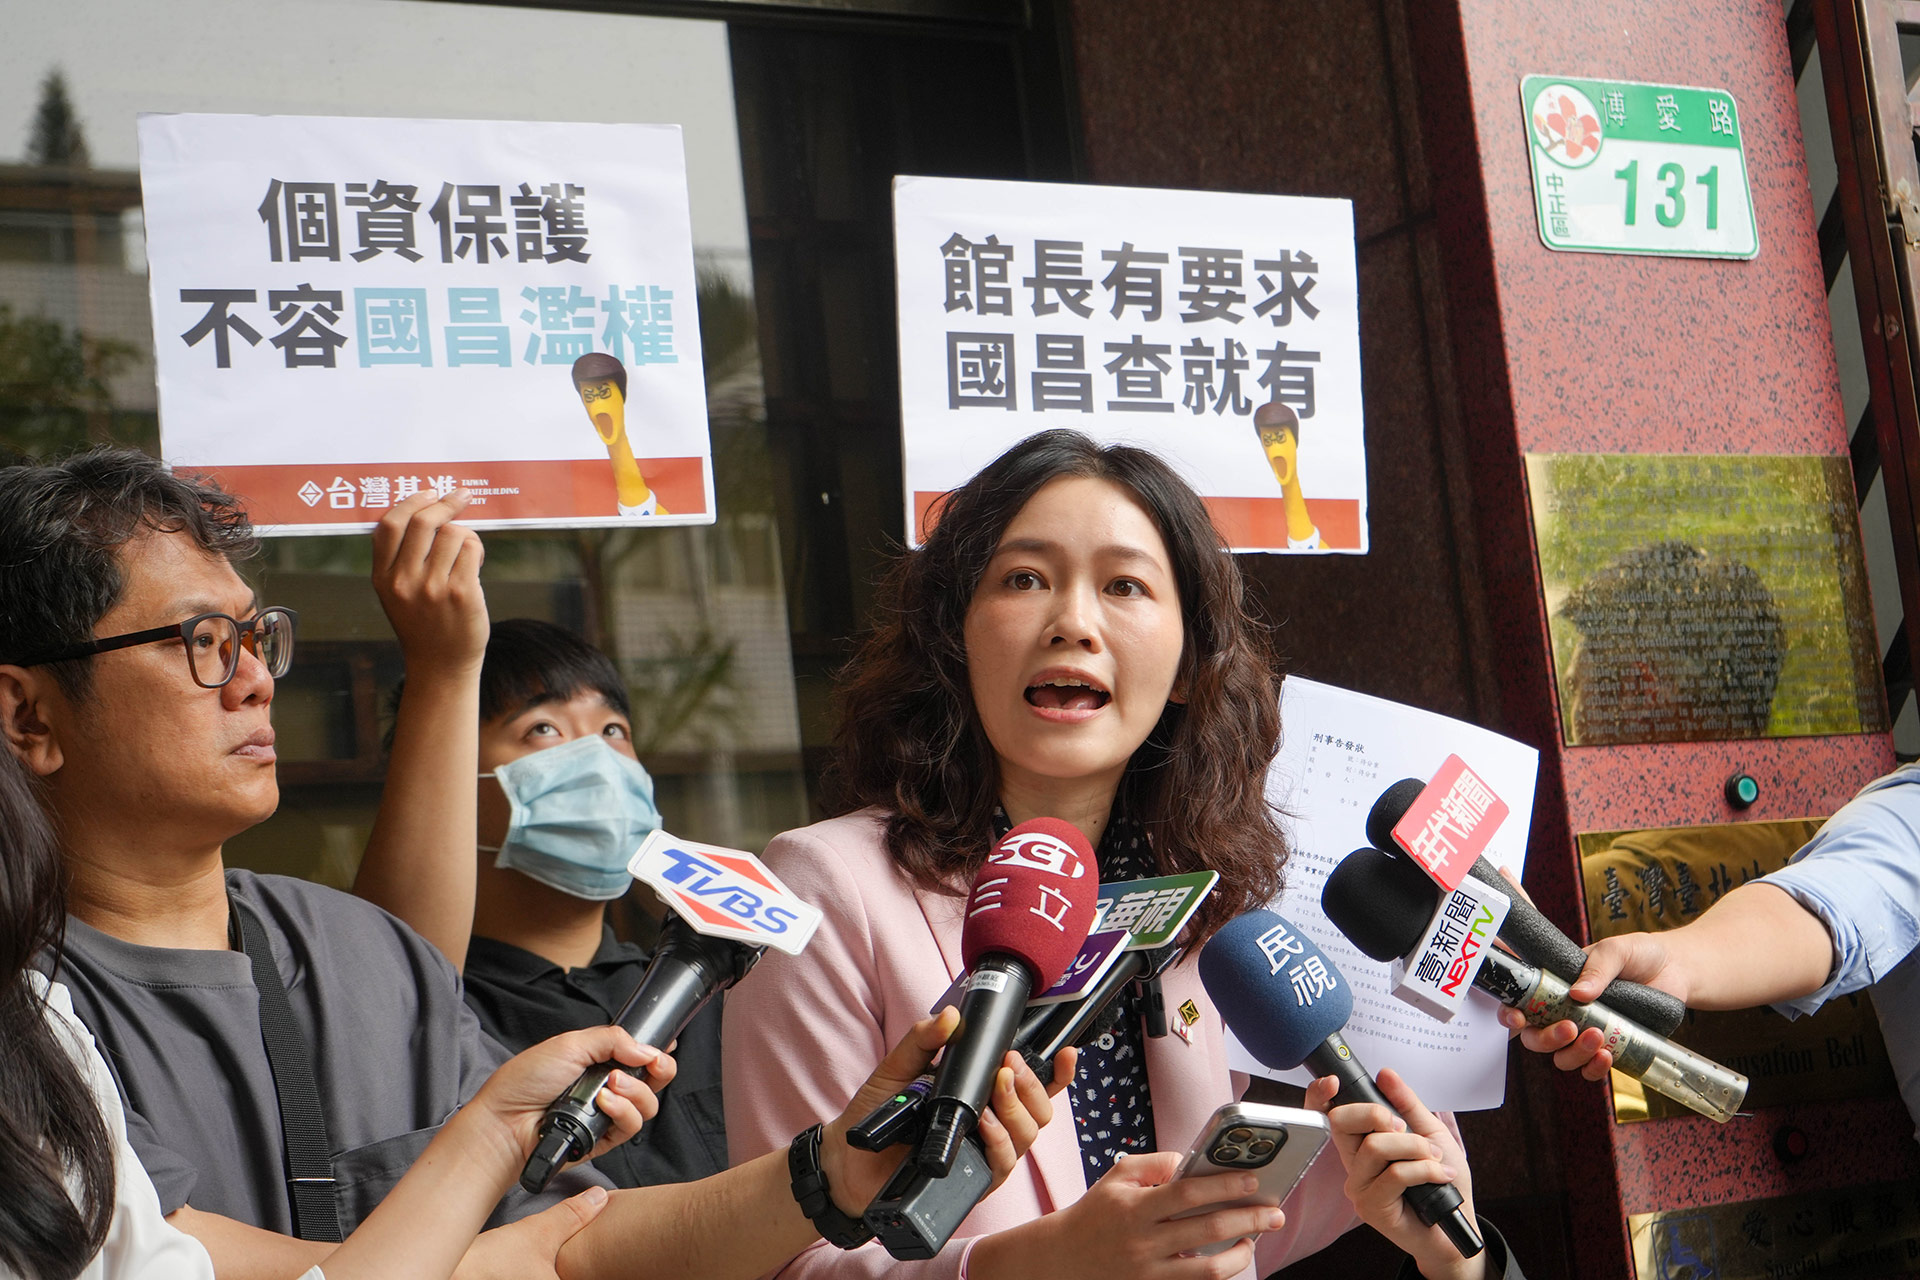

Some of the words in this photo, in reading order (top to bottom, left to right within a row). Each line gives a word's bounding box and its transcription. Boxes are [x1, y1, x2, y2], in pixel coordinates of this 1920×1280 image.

[1600, 89, 1735, 136] 博愛路
[257, 177, 593, 265] 個資保護
[1546, 172, 1571, 238] 中正區
[1614, 159, 1719, 230] 131
[939, 231, 1321, 328] 館長有要求
[178, 282, 680, 369] 不容國昌濫權
[945, 331, 1322, 420] 國昌查就有
[1313, 733, 1365, 754] 刑事告發狀
[1410, 768, 1497, 872] 年代新聞
[661, 848, 799, 934] TVBS
[968, 877, 1073, 933] 三立
[1255, 924, 1337, 1006] 民視
[1414, 889, 1479, 988] 壹新聞
[1825, 1034, 1868, 1069] Bell
[1741, 1189, 1920, 1250] 愛心服務
[1764, 1252, 1822, 1280] Special
